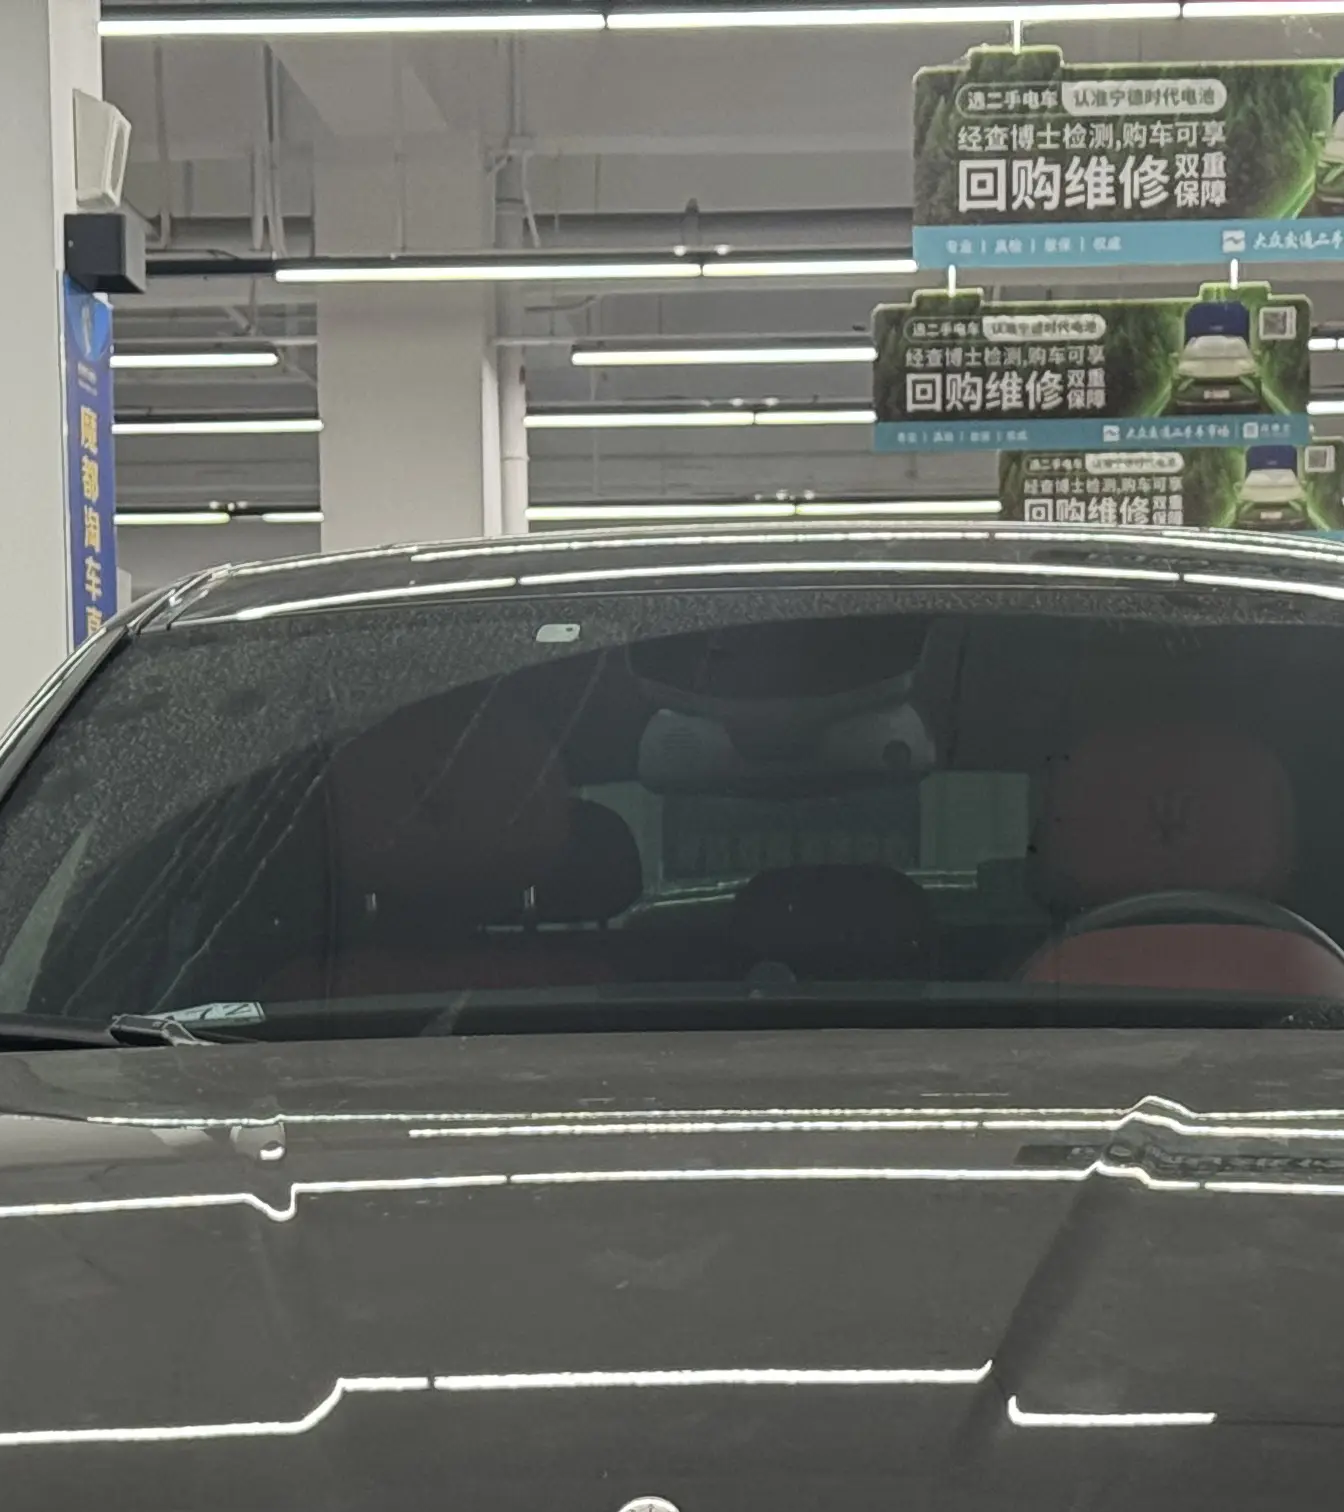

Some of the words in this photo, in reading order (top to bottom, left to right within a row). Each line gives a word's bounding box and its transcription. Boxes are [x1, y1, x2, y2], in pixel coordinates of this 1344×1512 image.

[958, 154, 1170, 213] 回购维修
[906, 370, 1064, 412] 回购维修
